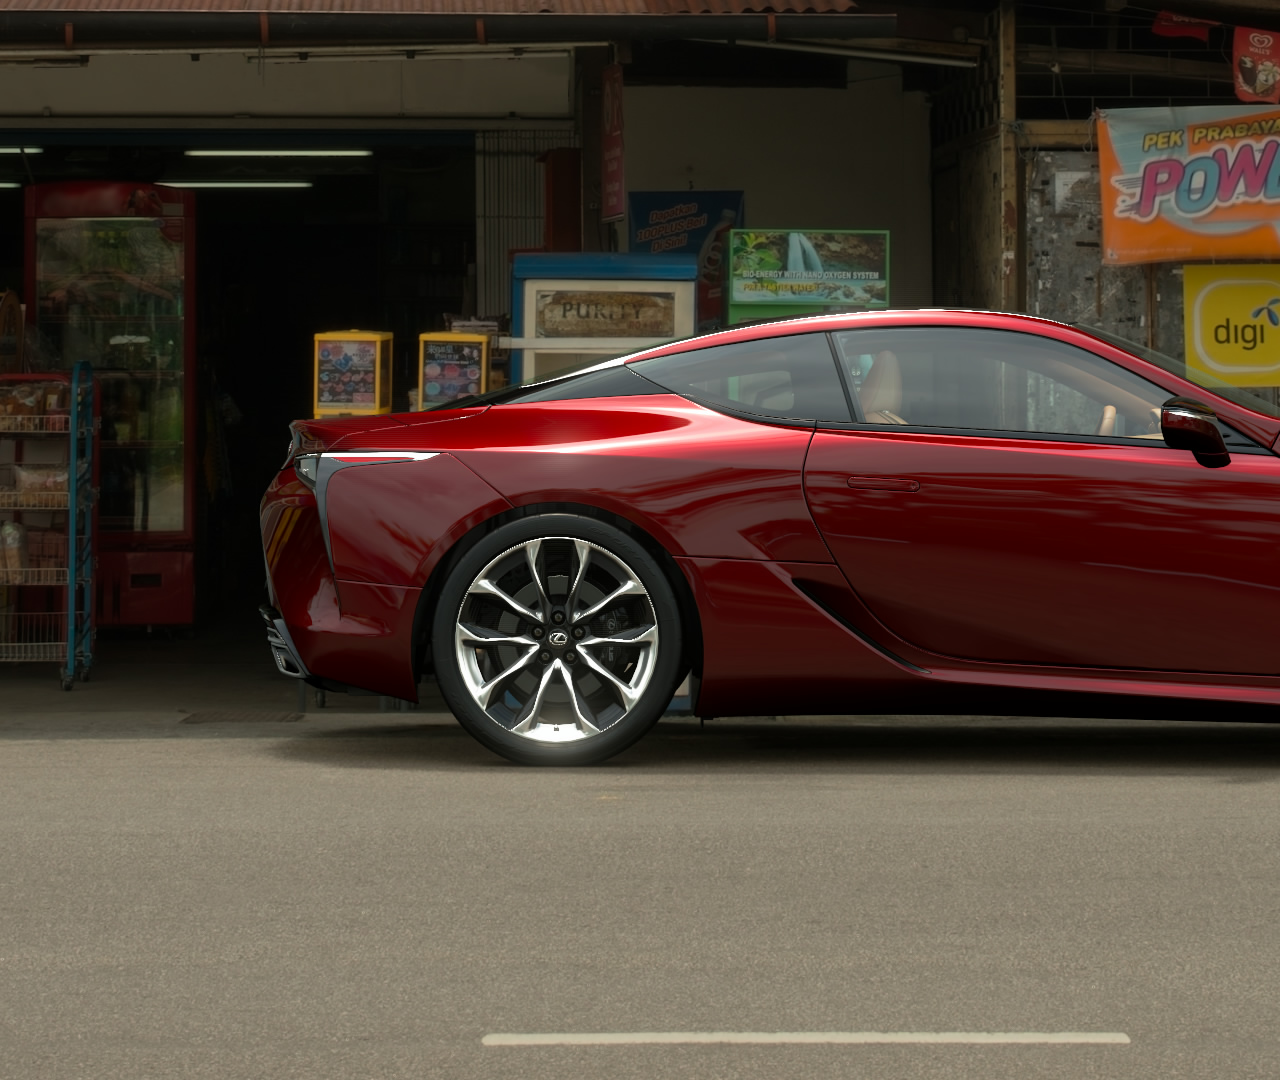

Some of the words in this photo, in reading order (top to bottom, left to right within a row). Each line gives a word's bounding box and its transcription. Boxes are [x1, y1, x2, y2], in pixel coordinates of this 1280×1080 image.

[1143, 130, 1183, 152] PEK
[650, 203, 697, 224] Dapatkan
[637, 220, 686, 242] 100PLUS
[685, 214, 707, 231] Beri
[652, 240, 665, 253] Di
[742, 270, 782, 279] BIO-ENERGY
[784, 271, 802, 279] WITH
[803, 271, 822, 279] NANO
[823, 271, 851, 280] OXYGEN
[852, 271, 879, 280] SYSTEM
[561, 302, 641, 320] PURITY
[1214, 317, 1265, 351] digi
